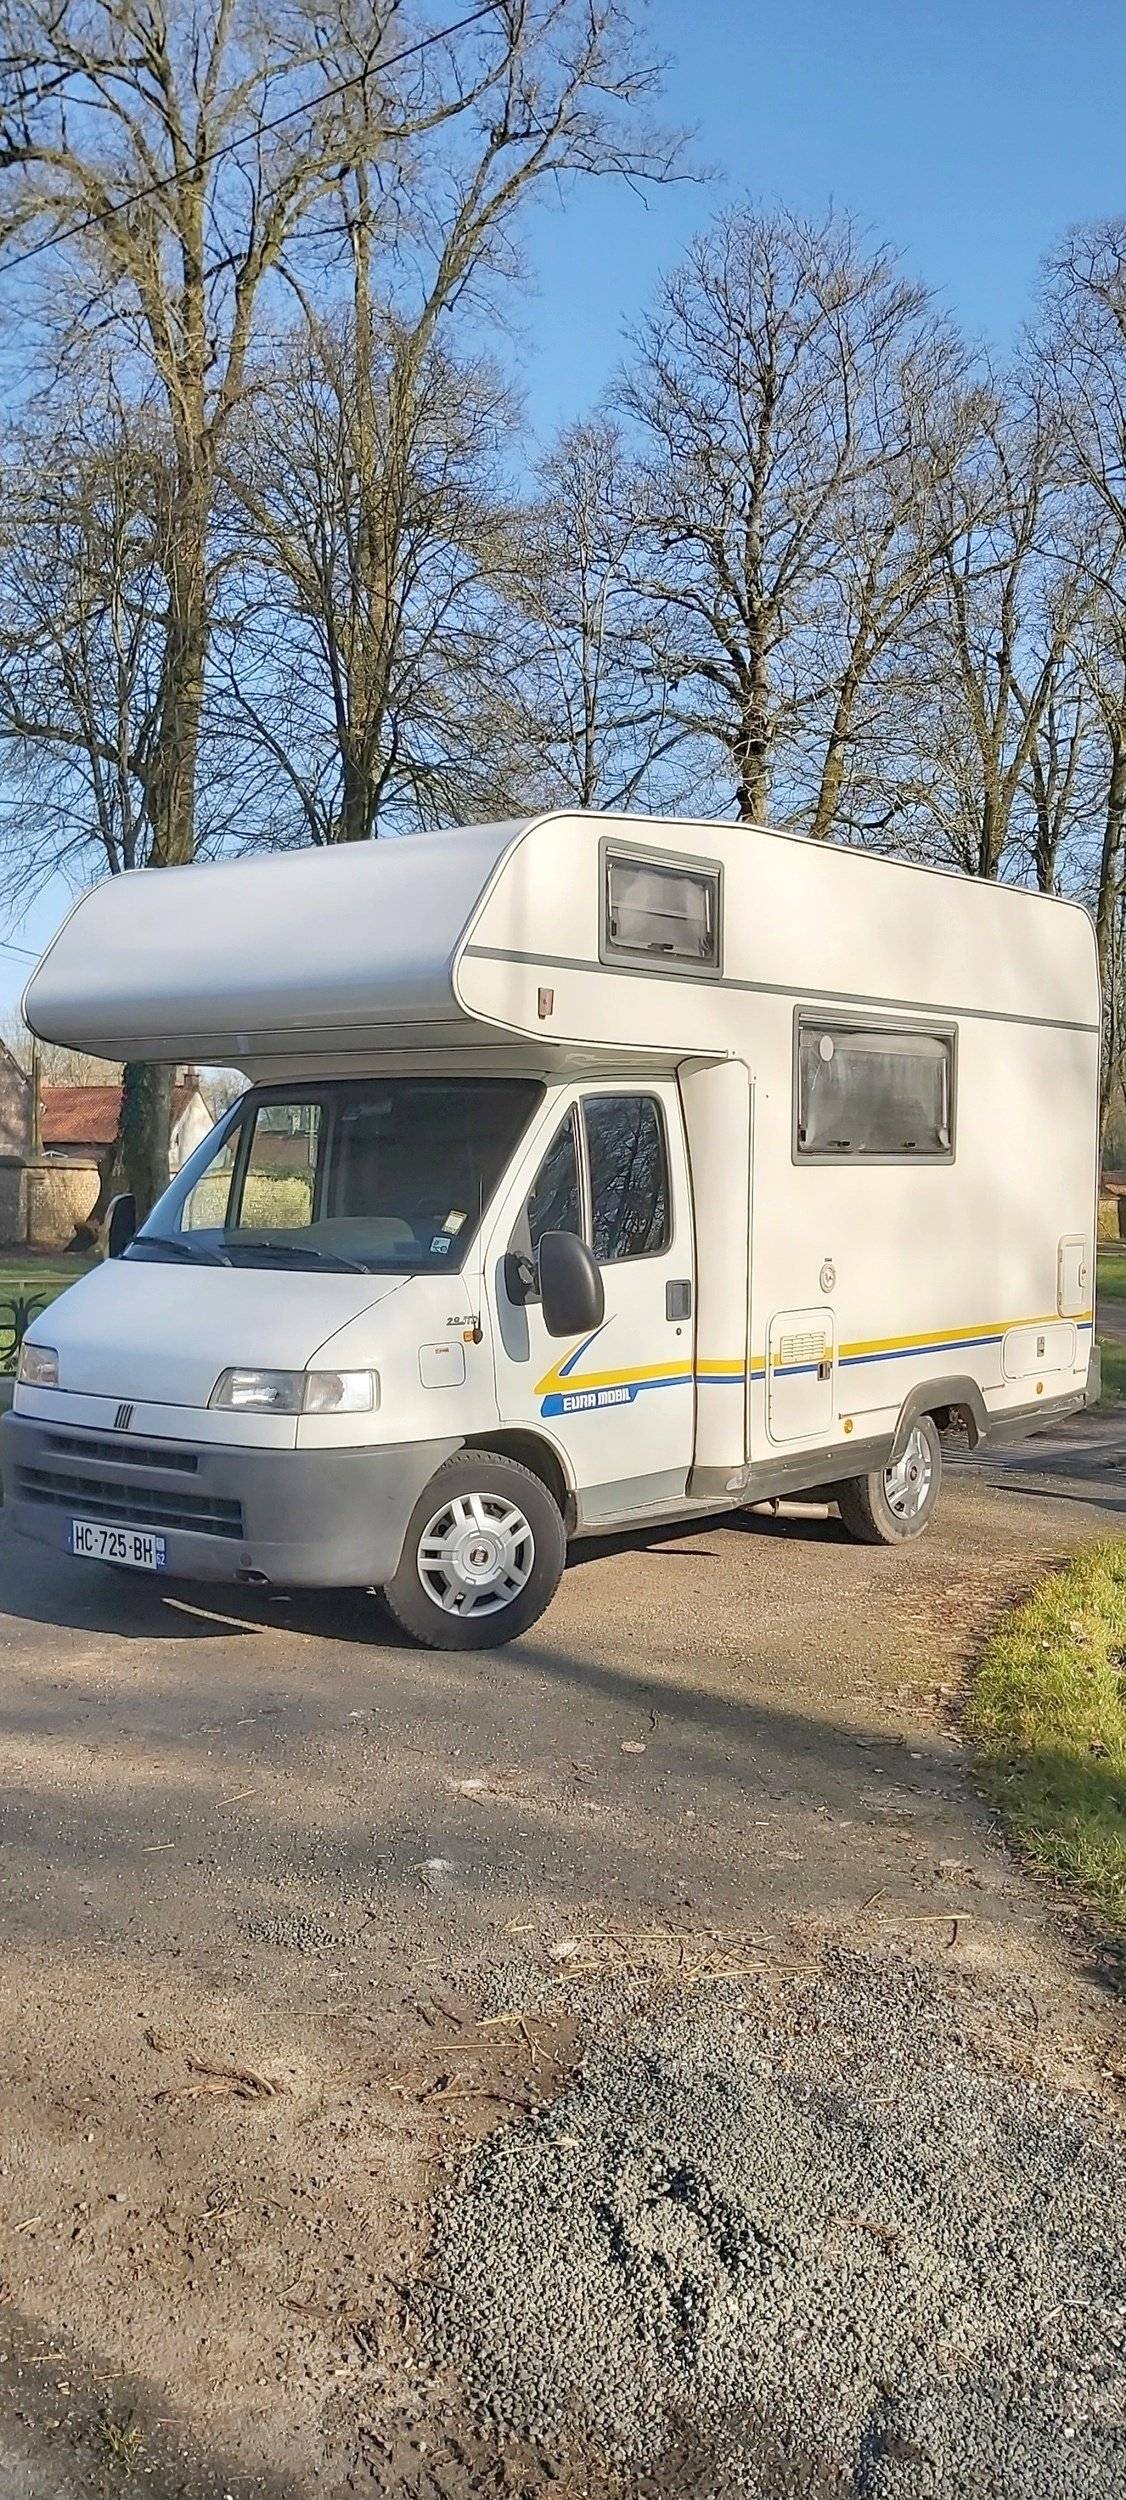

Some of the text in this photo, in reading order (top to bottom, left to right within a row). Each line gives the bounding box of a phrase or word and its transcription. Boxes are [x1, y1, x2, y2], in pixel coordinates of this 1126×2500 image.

[563, 1387, 631, 1411] EURA MOBIL
[76, 1525, 153, 1564] HC-725-BH
